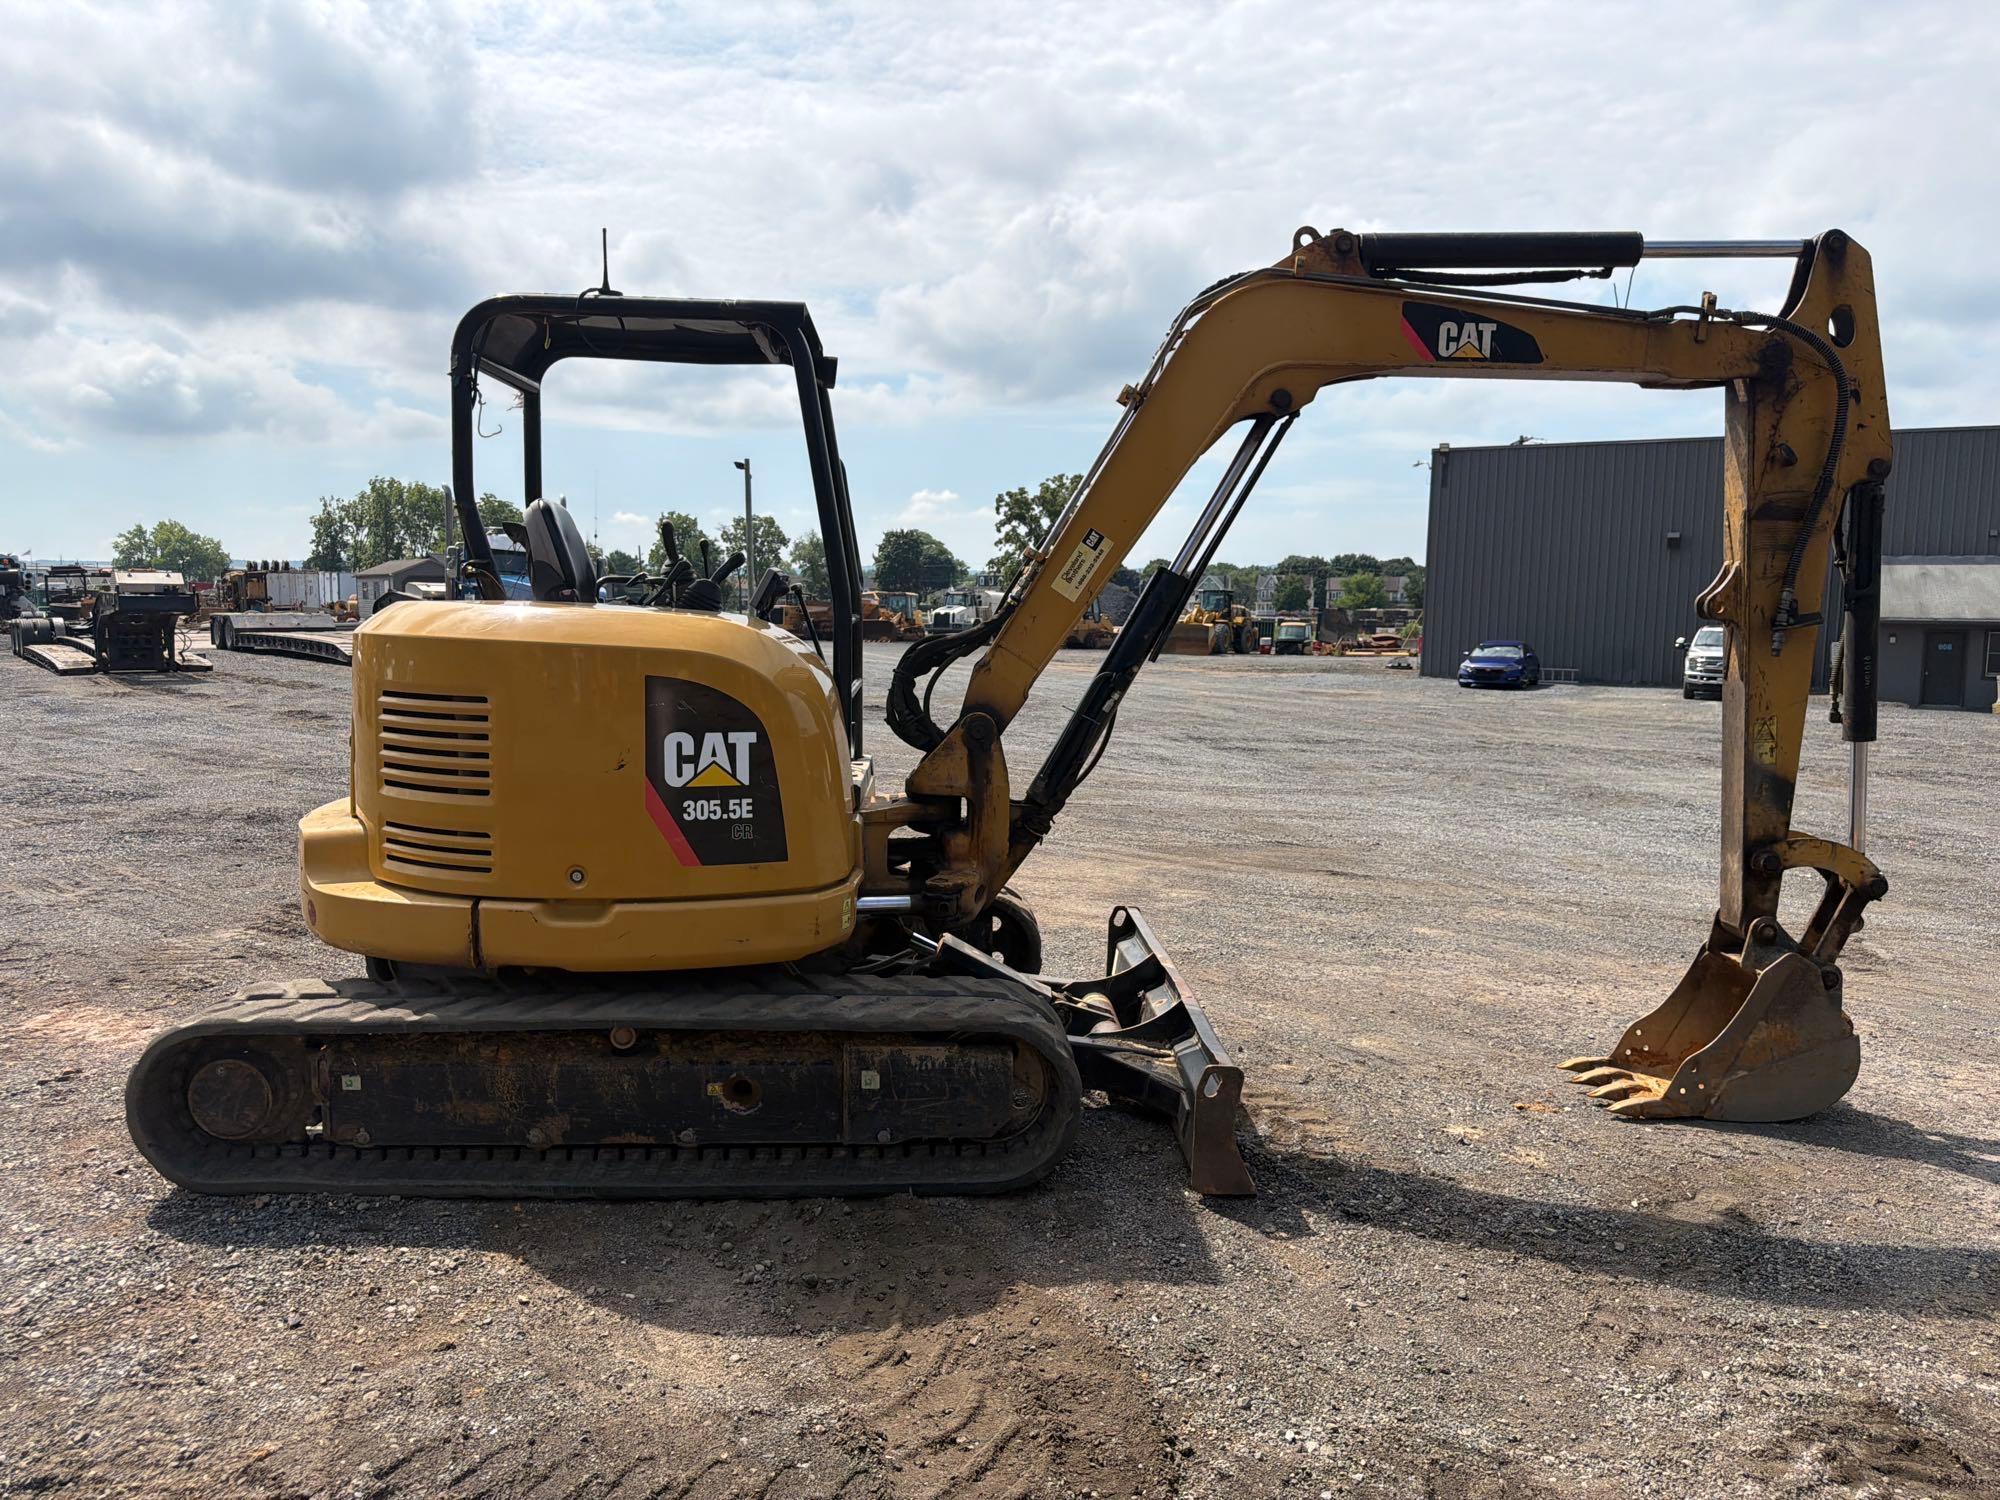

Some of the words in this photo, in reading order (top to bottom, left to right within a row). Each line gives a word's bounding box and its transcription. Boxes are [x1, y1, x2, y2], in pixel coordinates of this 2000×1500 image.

[1438, 321, 1497, 358] CAT
[1085, 530, 1100, 547] CAT
[1061, 550, 1083, 581] Cleveland
[1065, 558, 1086, 585] Brothers
[663, 731, 757, 788] CAT
[682, 798, 753, 821] 305.5E
[731, 823, 754, 840] CR
